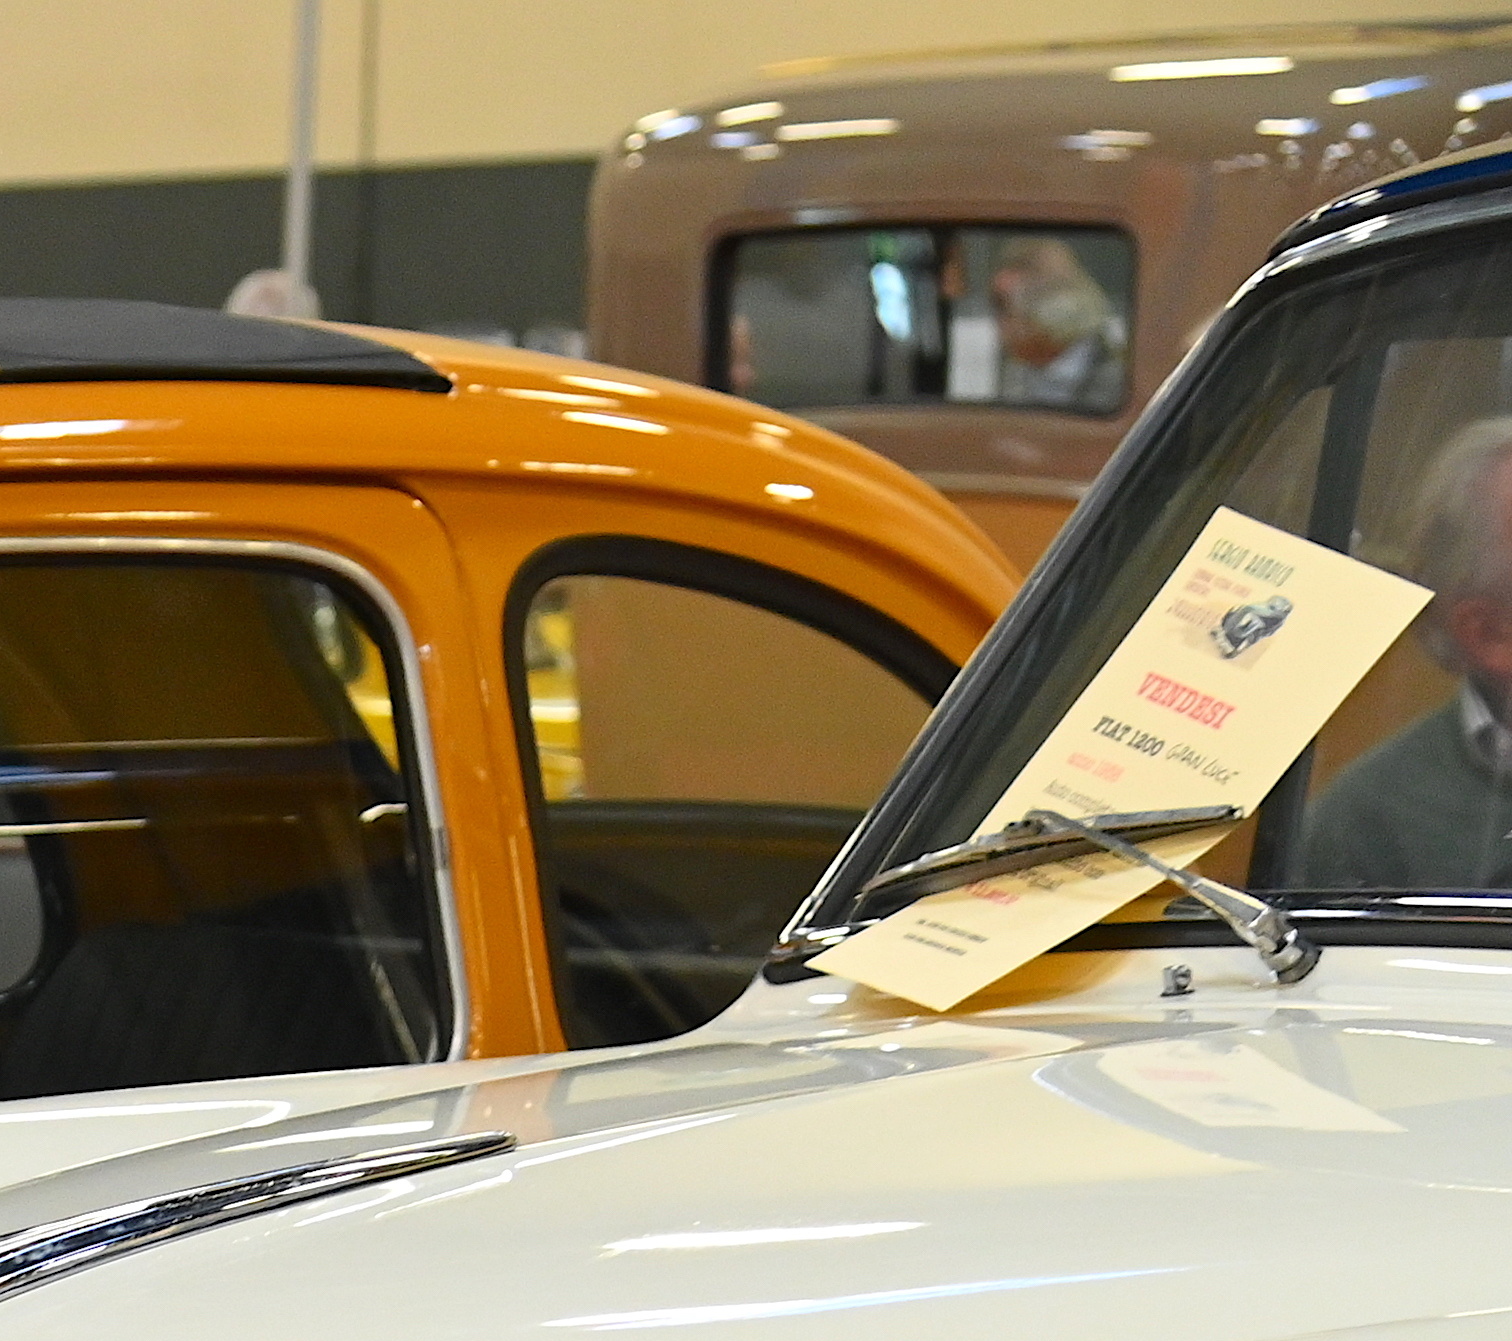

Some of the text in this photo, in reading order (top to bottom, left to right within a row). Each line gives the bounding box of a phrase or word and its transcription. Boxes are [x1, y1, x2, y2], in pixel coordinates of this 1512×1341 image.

[1136, 671, 1238, 731] VENDESI
[1091, 715, 1165, 757] FIAT 1200
